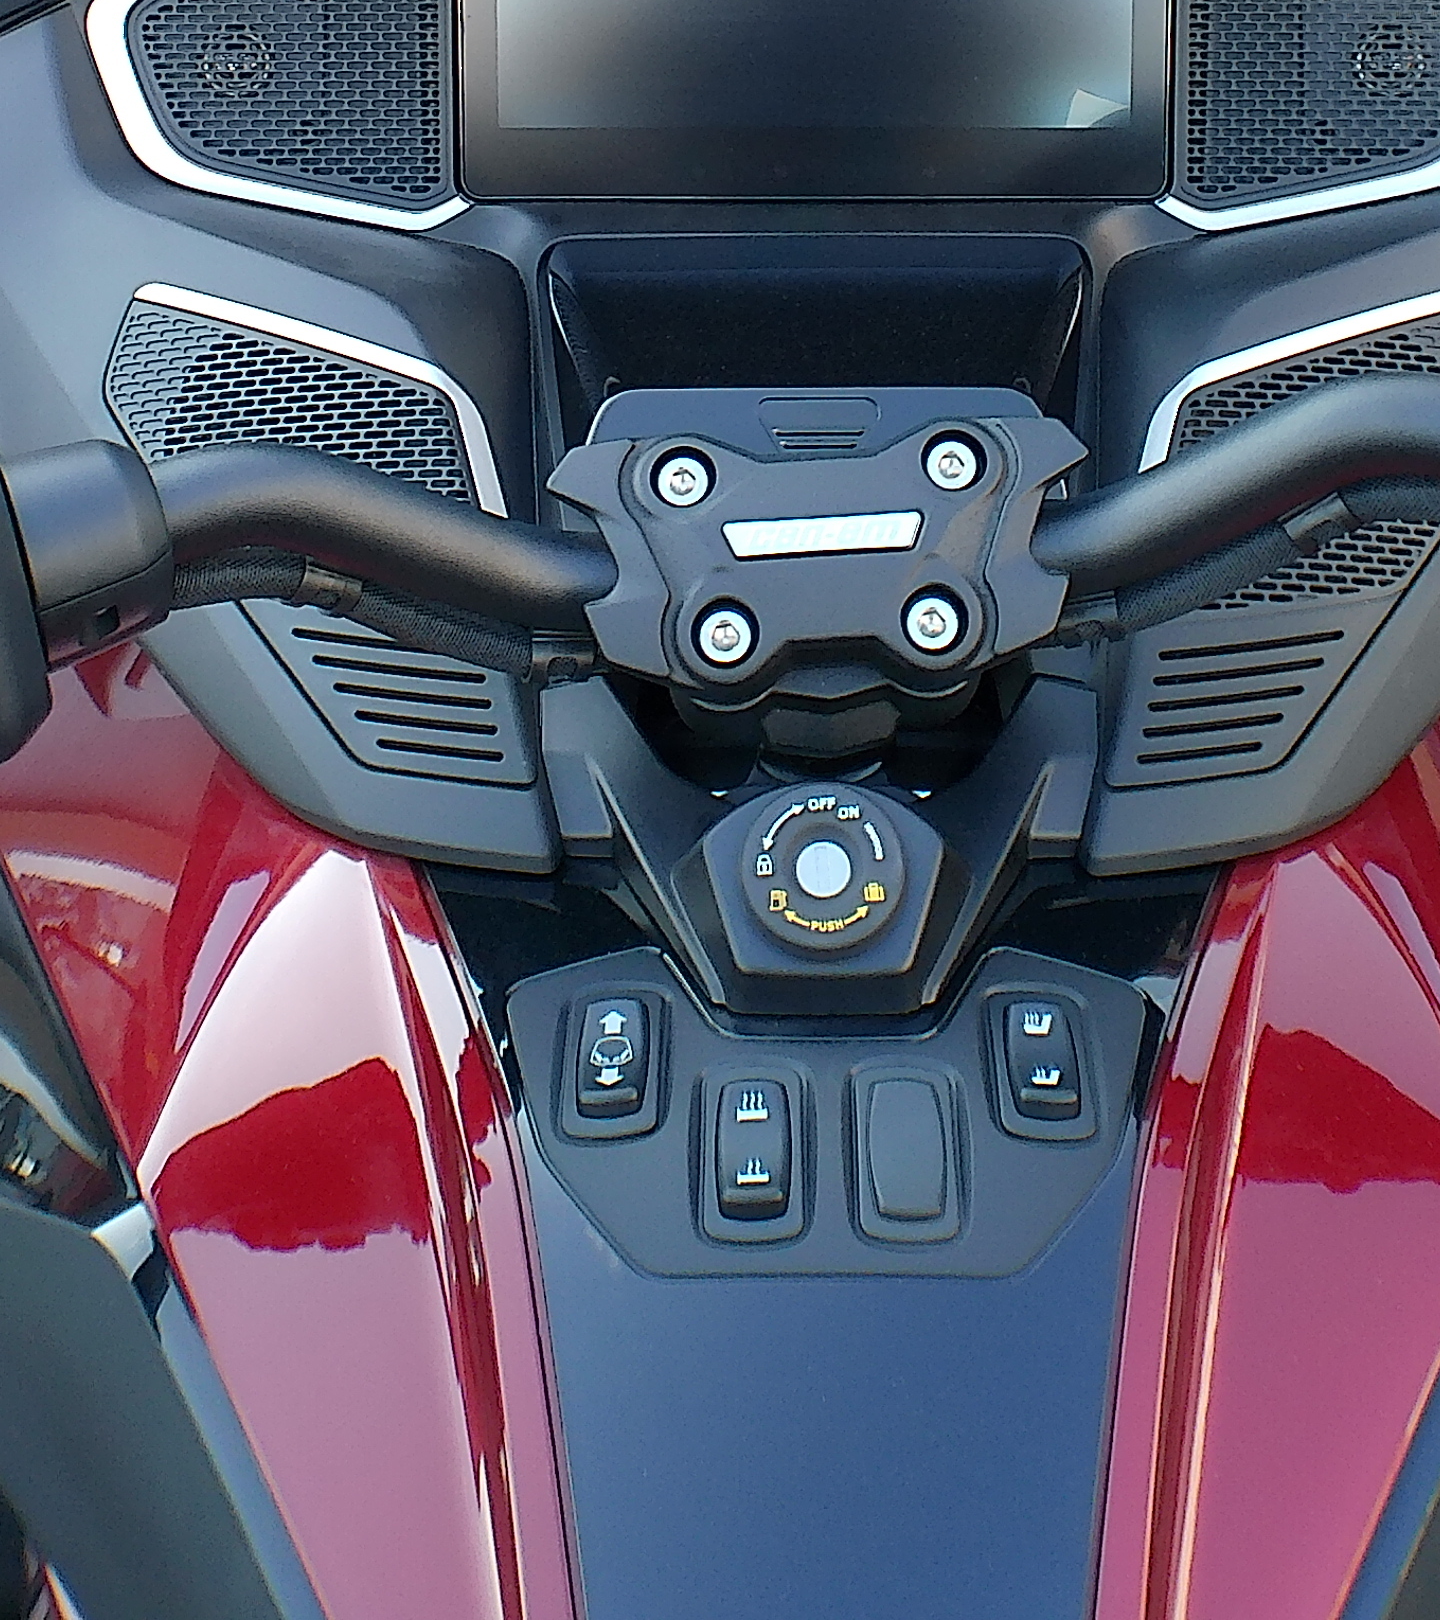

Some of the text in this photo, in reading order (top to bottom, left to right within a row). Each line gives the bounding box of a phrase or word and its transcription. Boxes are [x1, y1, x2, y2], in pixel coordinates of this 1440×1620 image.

[807, 796, 860, 820] OFF ON
[810, 919, 845, 932] PUSH
